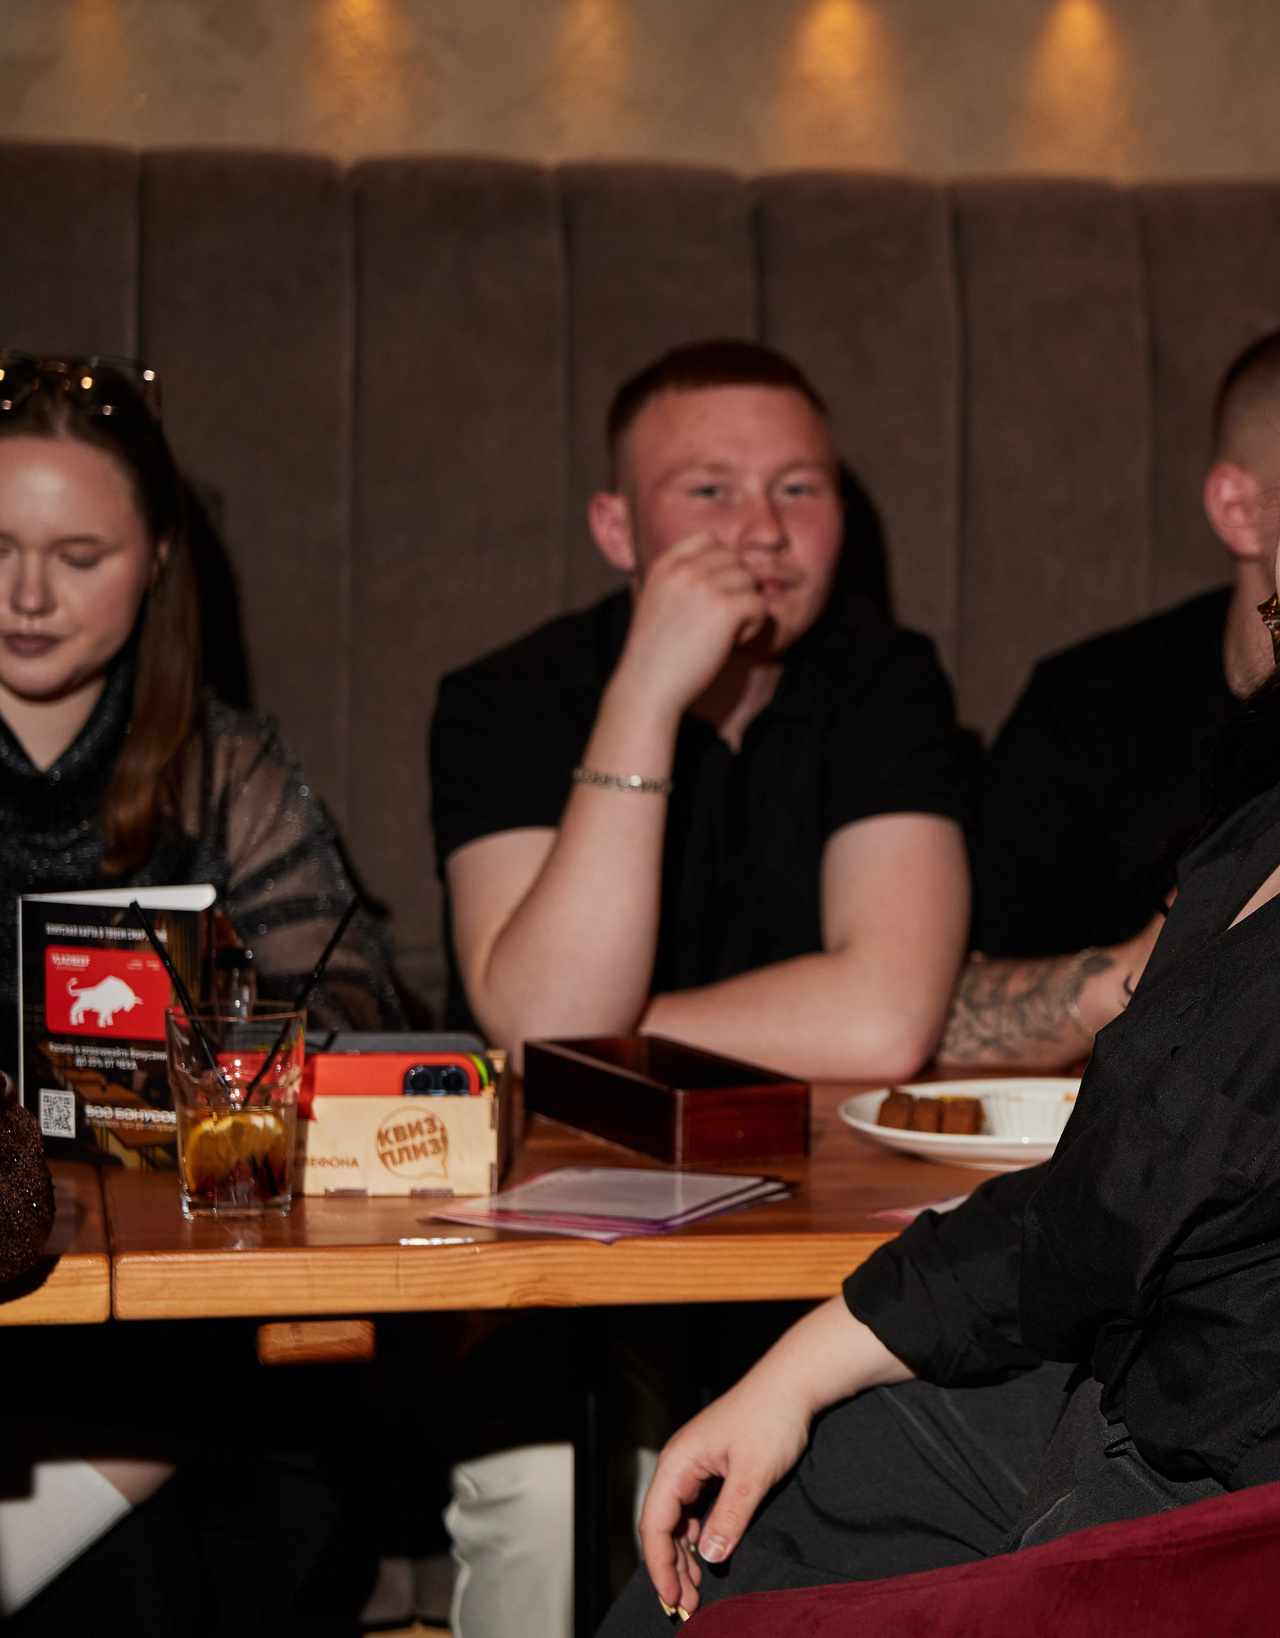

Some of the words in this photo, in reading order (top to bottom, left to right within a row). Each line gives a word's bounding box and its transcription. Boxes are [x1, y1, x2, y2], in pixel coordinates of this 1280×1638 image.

[79, 924, 98, 938] КАРТА
[51, 953, 90, 967] VLADBEEF
[75, 1056, 86, 1067] ДО
[88, 1056, 103, 1068] 20%
[105, 1058, 115, 1069] ОТ
[116, 1058, 138, 1070] ЧЕКА
[85, 1104, 113, 1119] 500
